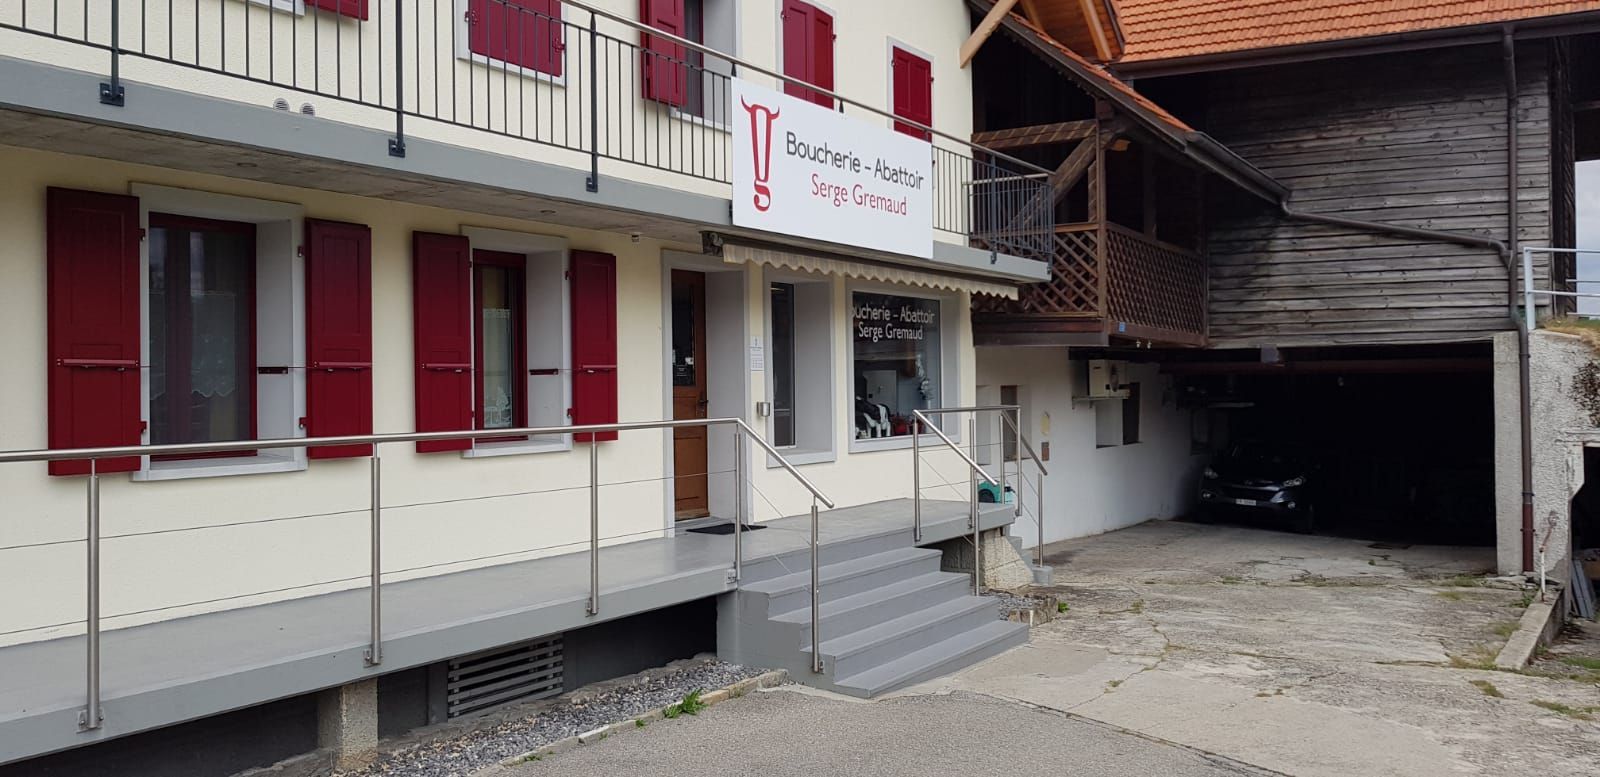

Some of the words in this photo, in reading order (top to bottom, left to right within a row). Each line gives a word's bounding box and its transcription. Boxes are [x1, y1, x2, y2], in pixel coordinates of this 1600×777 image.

[786, 131, 861, 173] Boucherie
[874, 157, 924, 190] Abattoir
[811, 173, 848, 207] Serge
[852, 183, 908, 216] Gremaud
[901, 306, 935, 323] Abattoir
[859, 322, 882, 342] Serge
[885, 323, 923, 340] Gremaud
